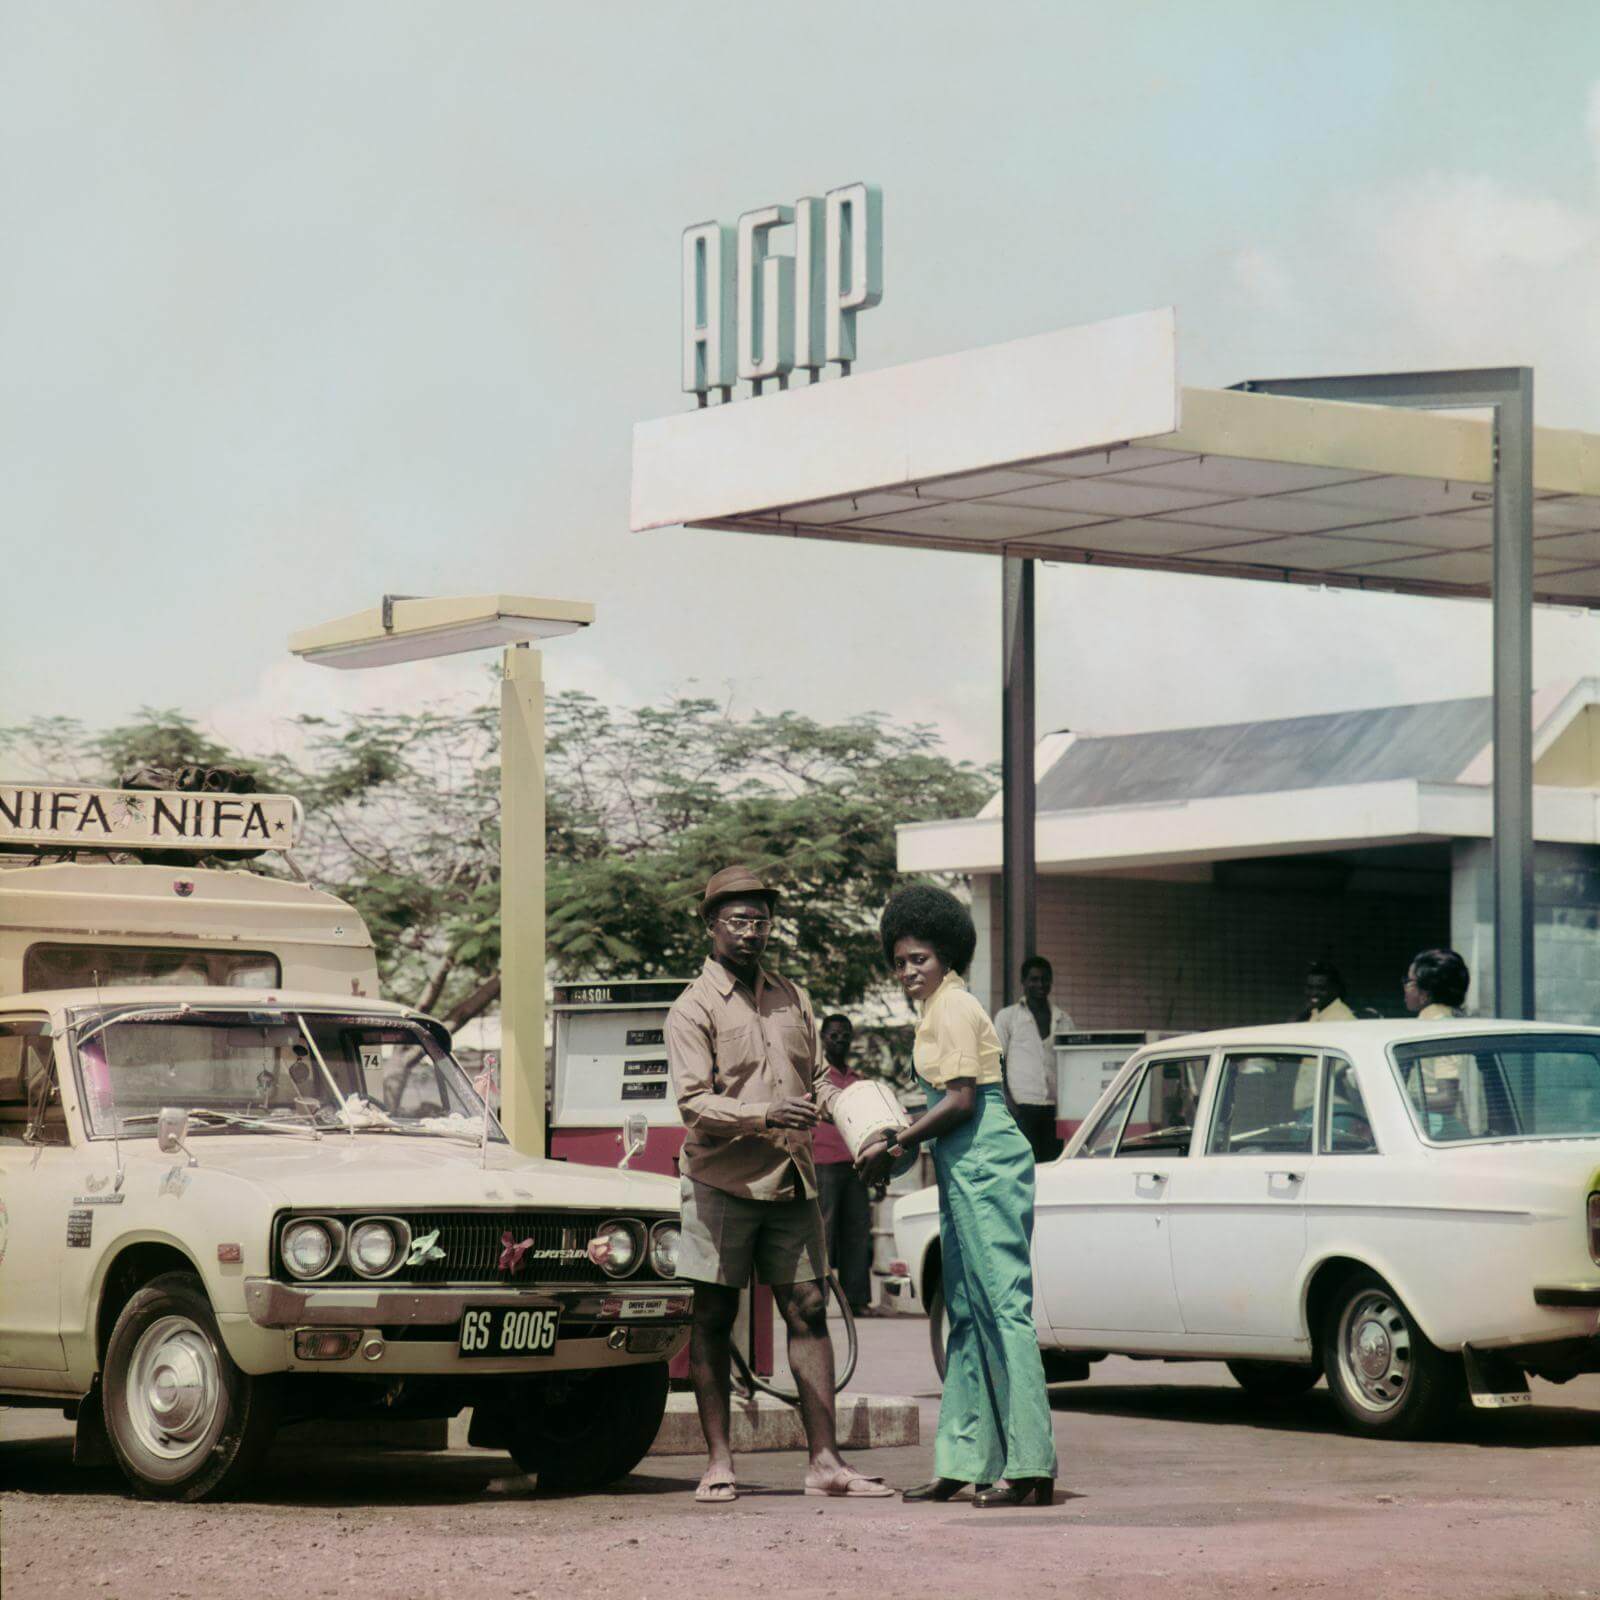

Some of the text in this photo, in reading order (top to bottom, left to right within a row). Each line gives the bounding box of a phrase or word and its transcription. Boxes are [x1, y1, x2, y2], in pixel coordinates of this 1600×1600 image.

[681, 182, 883, 393] AGIP
[152, 797, 271, 838] NIFA
[363, 1054, 379, 1067] 74
[533, 1249, 588, 1258] DATSUN
[461, 1310, 558, 1350] GS 8005
